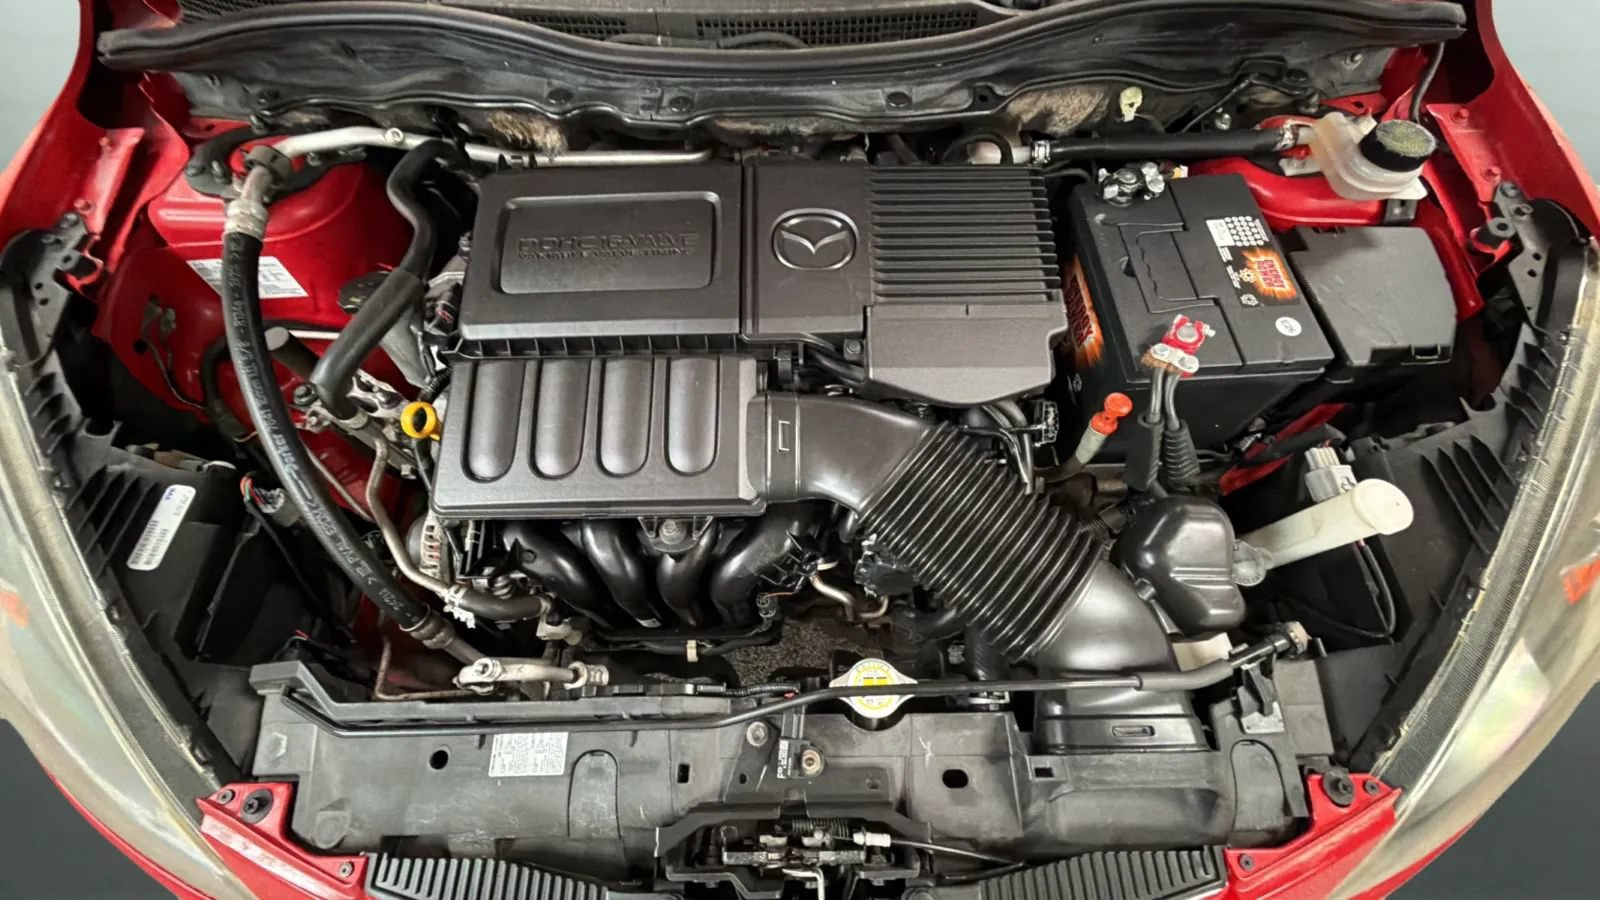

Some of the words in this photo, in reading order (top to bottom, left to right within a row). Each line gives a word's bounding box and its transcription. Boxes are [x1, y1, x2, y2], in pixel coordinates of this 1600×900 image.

[1256, 260, 1275, 288] POWER
[1264, 258, 1286, 288] ENERGY
[273, 434, 299, 473] Parker
